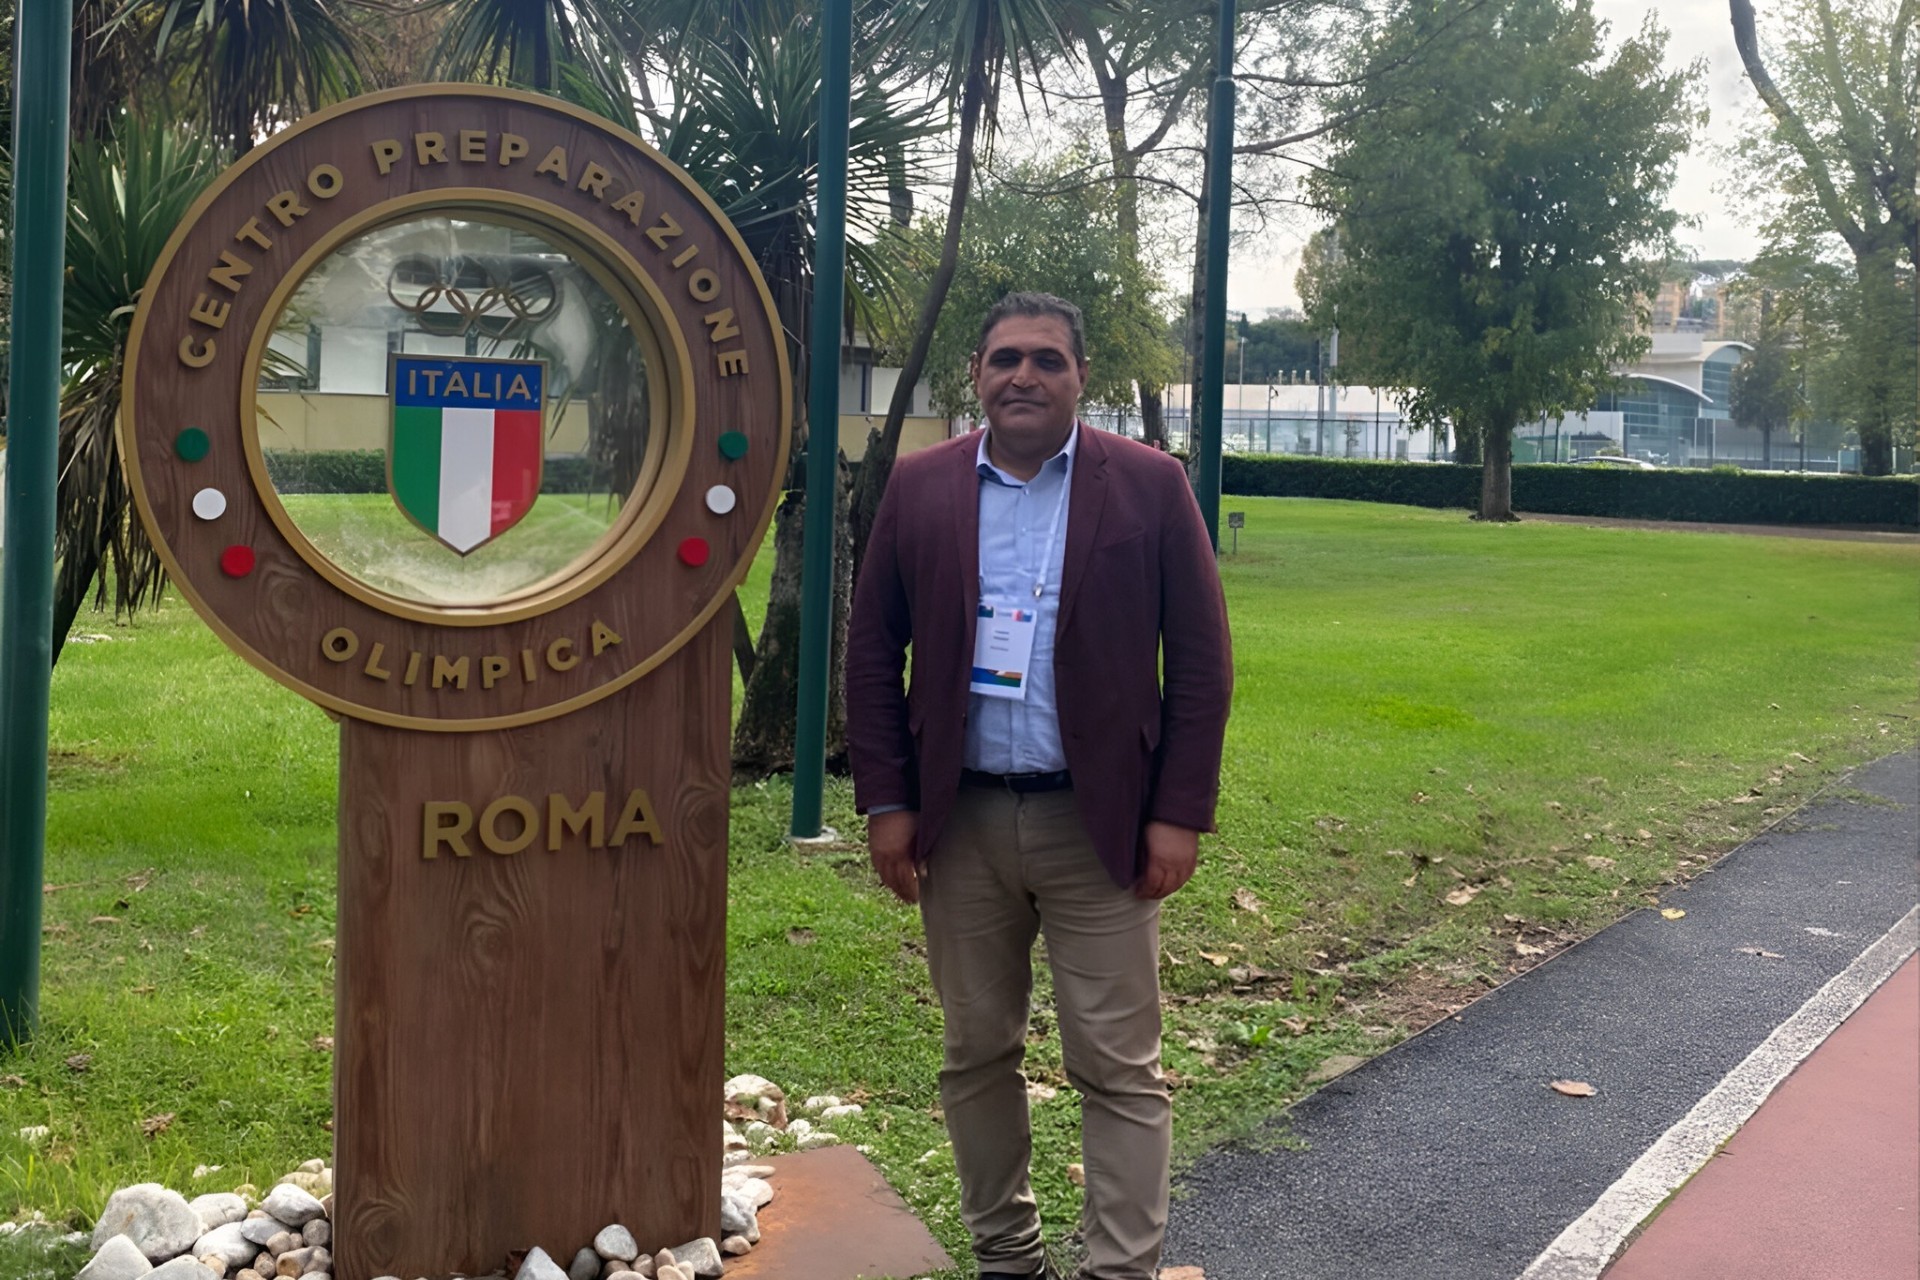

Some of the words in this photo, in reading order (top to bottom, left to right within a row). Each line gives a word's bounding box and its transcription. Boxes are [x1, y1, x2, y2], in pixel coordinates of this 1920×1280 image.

[178, 163, 343, 368] CENTRO
[372, 129, 749, 378] PREPARAZIONE
[409, 370, 532, 401] ITALIA
[321, 620, 623, 690] OLIMPICA
[422, 788, 665, 859] ROMA
